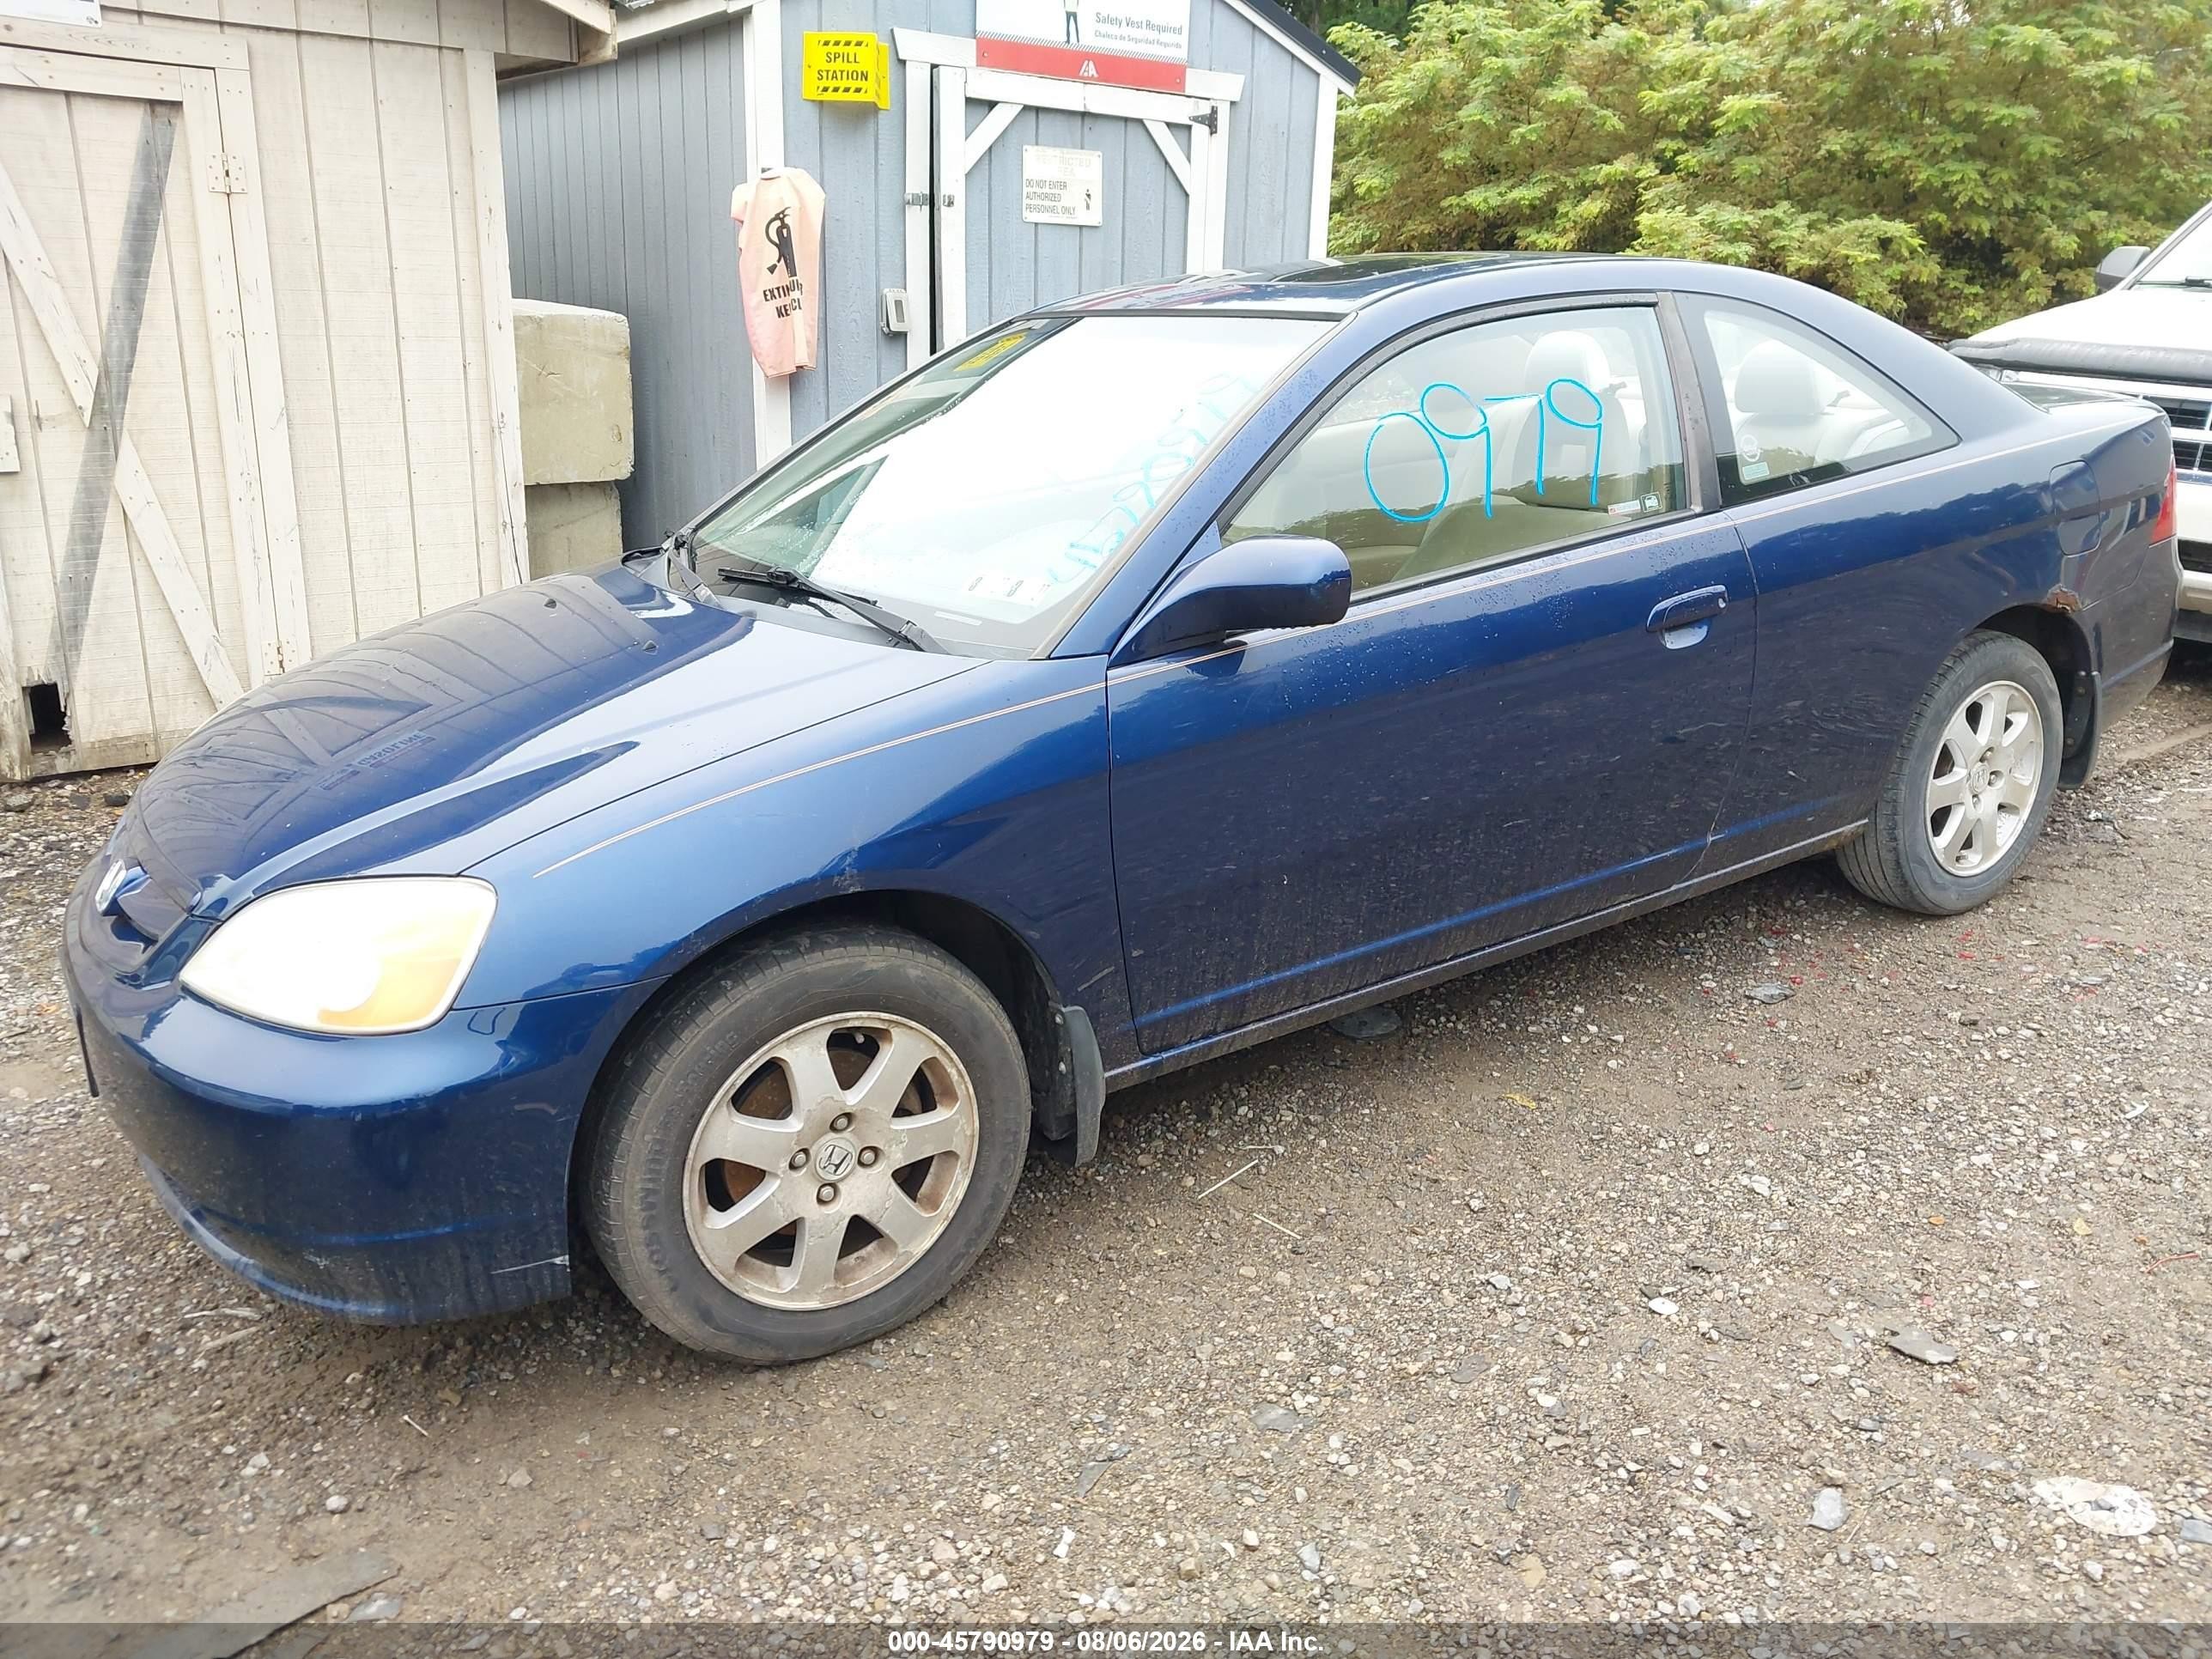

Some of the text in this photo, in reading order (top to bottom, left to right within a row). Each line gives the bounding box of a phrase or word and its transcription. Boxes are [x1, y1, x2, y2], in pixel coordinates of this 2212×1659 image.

[1095, 12, 1182, 35] Safety Vest Required
[825, 52, 860, 64] SPILL
[817, 70, 868, 82] STATION
[1025, 179, 1067, 191] DO NOT ENTER
[1025, 191, 1061, 202] AUTHORIZED
[1025, 204, 1076, 215] PERSONNEL ONLY
[1364, 379, 1603, 522] 0979
